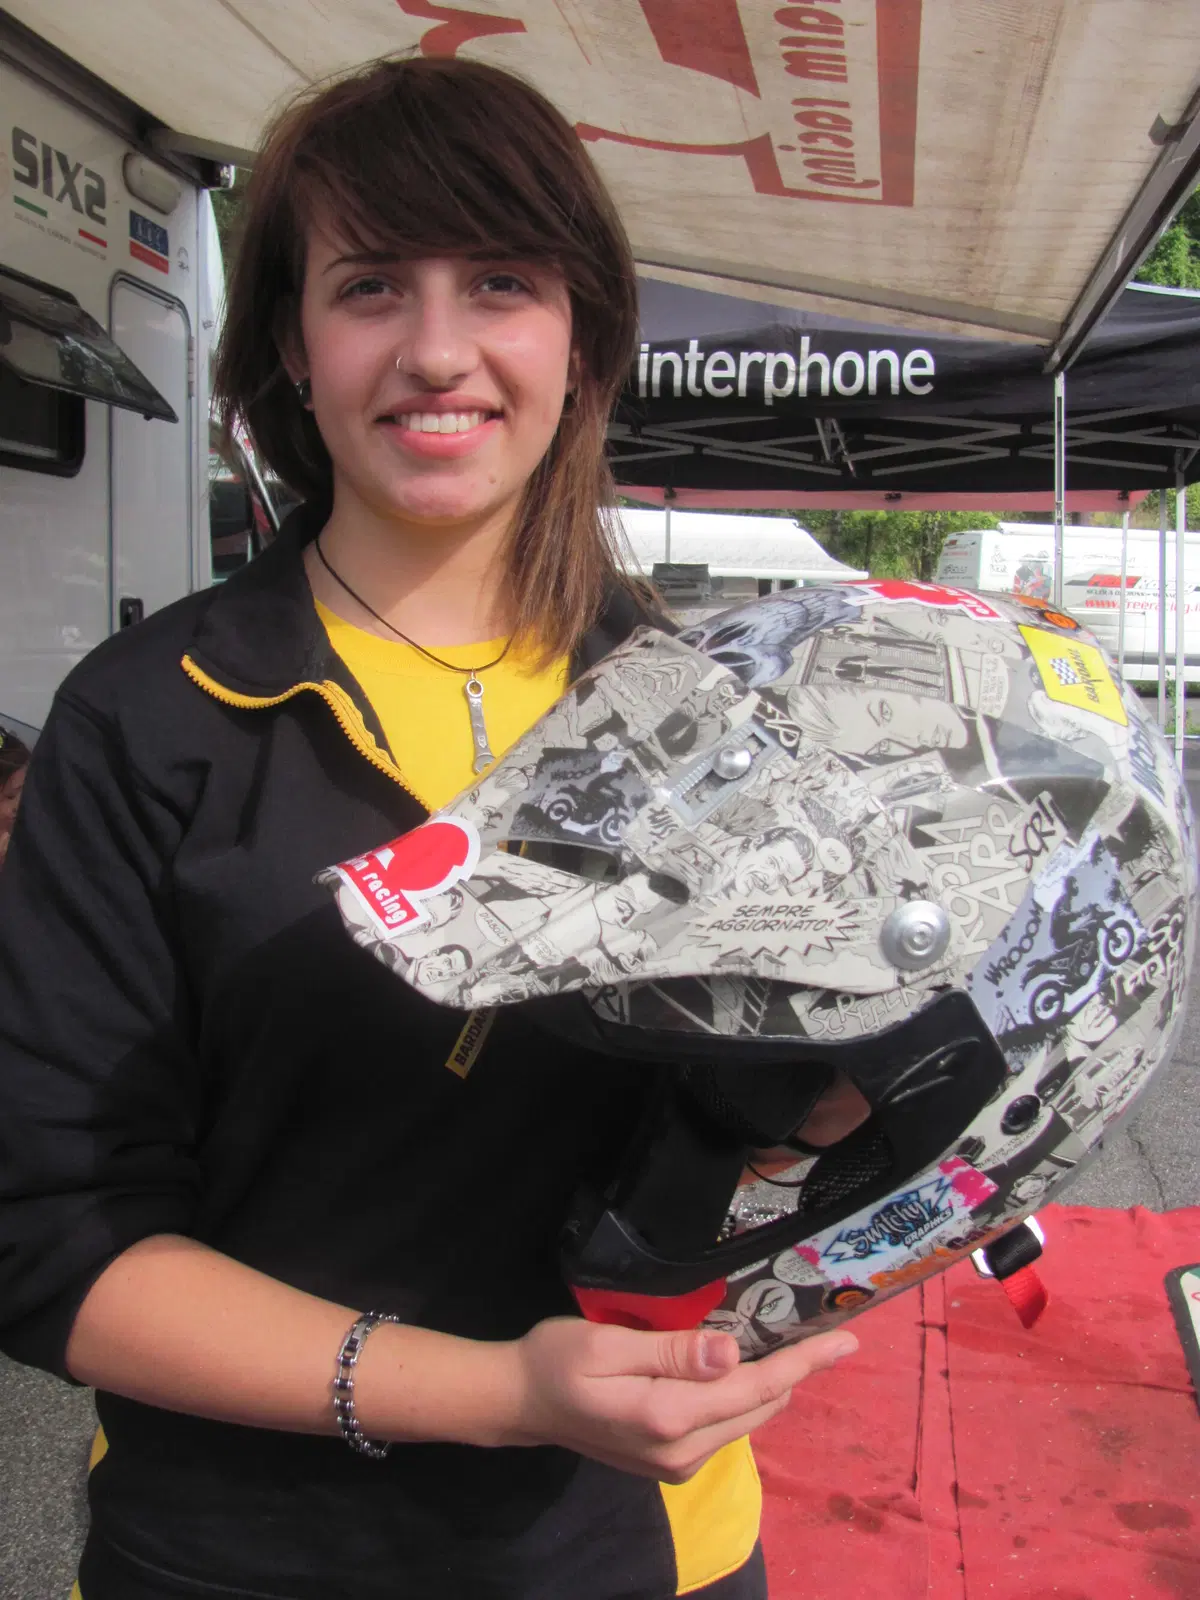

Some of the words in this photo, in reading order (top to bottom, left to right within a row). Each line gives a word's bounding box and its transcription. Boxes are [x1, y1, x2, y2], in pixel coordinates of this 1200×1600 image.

[638, 336, 936, 406] interphone
[363, 871, 409, 926] racing
[732, 904, 817, 919] SEMPRE
[479, 911, 509, 946] DIABOLIK
[706, 919, 836, 933] AGGIORNATO!
[984, 898, 1044, 988] WROOOM
[903, 1206, 954, 1249] GRAPHICS
